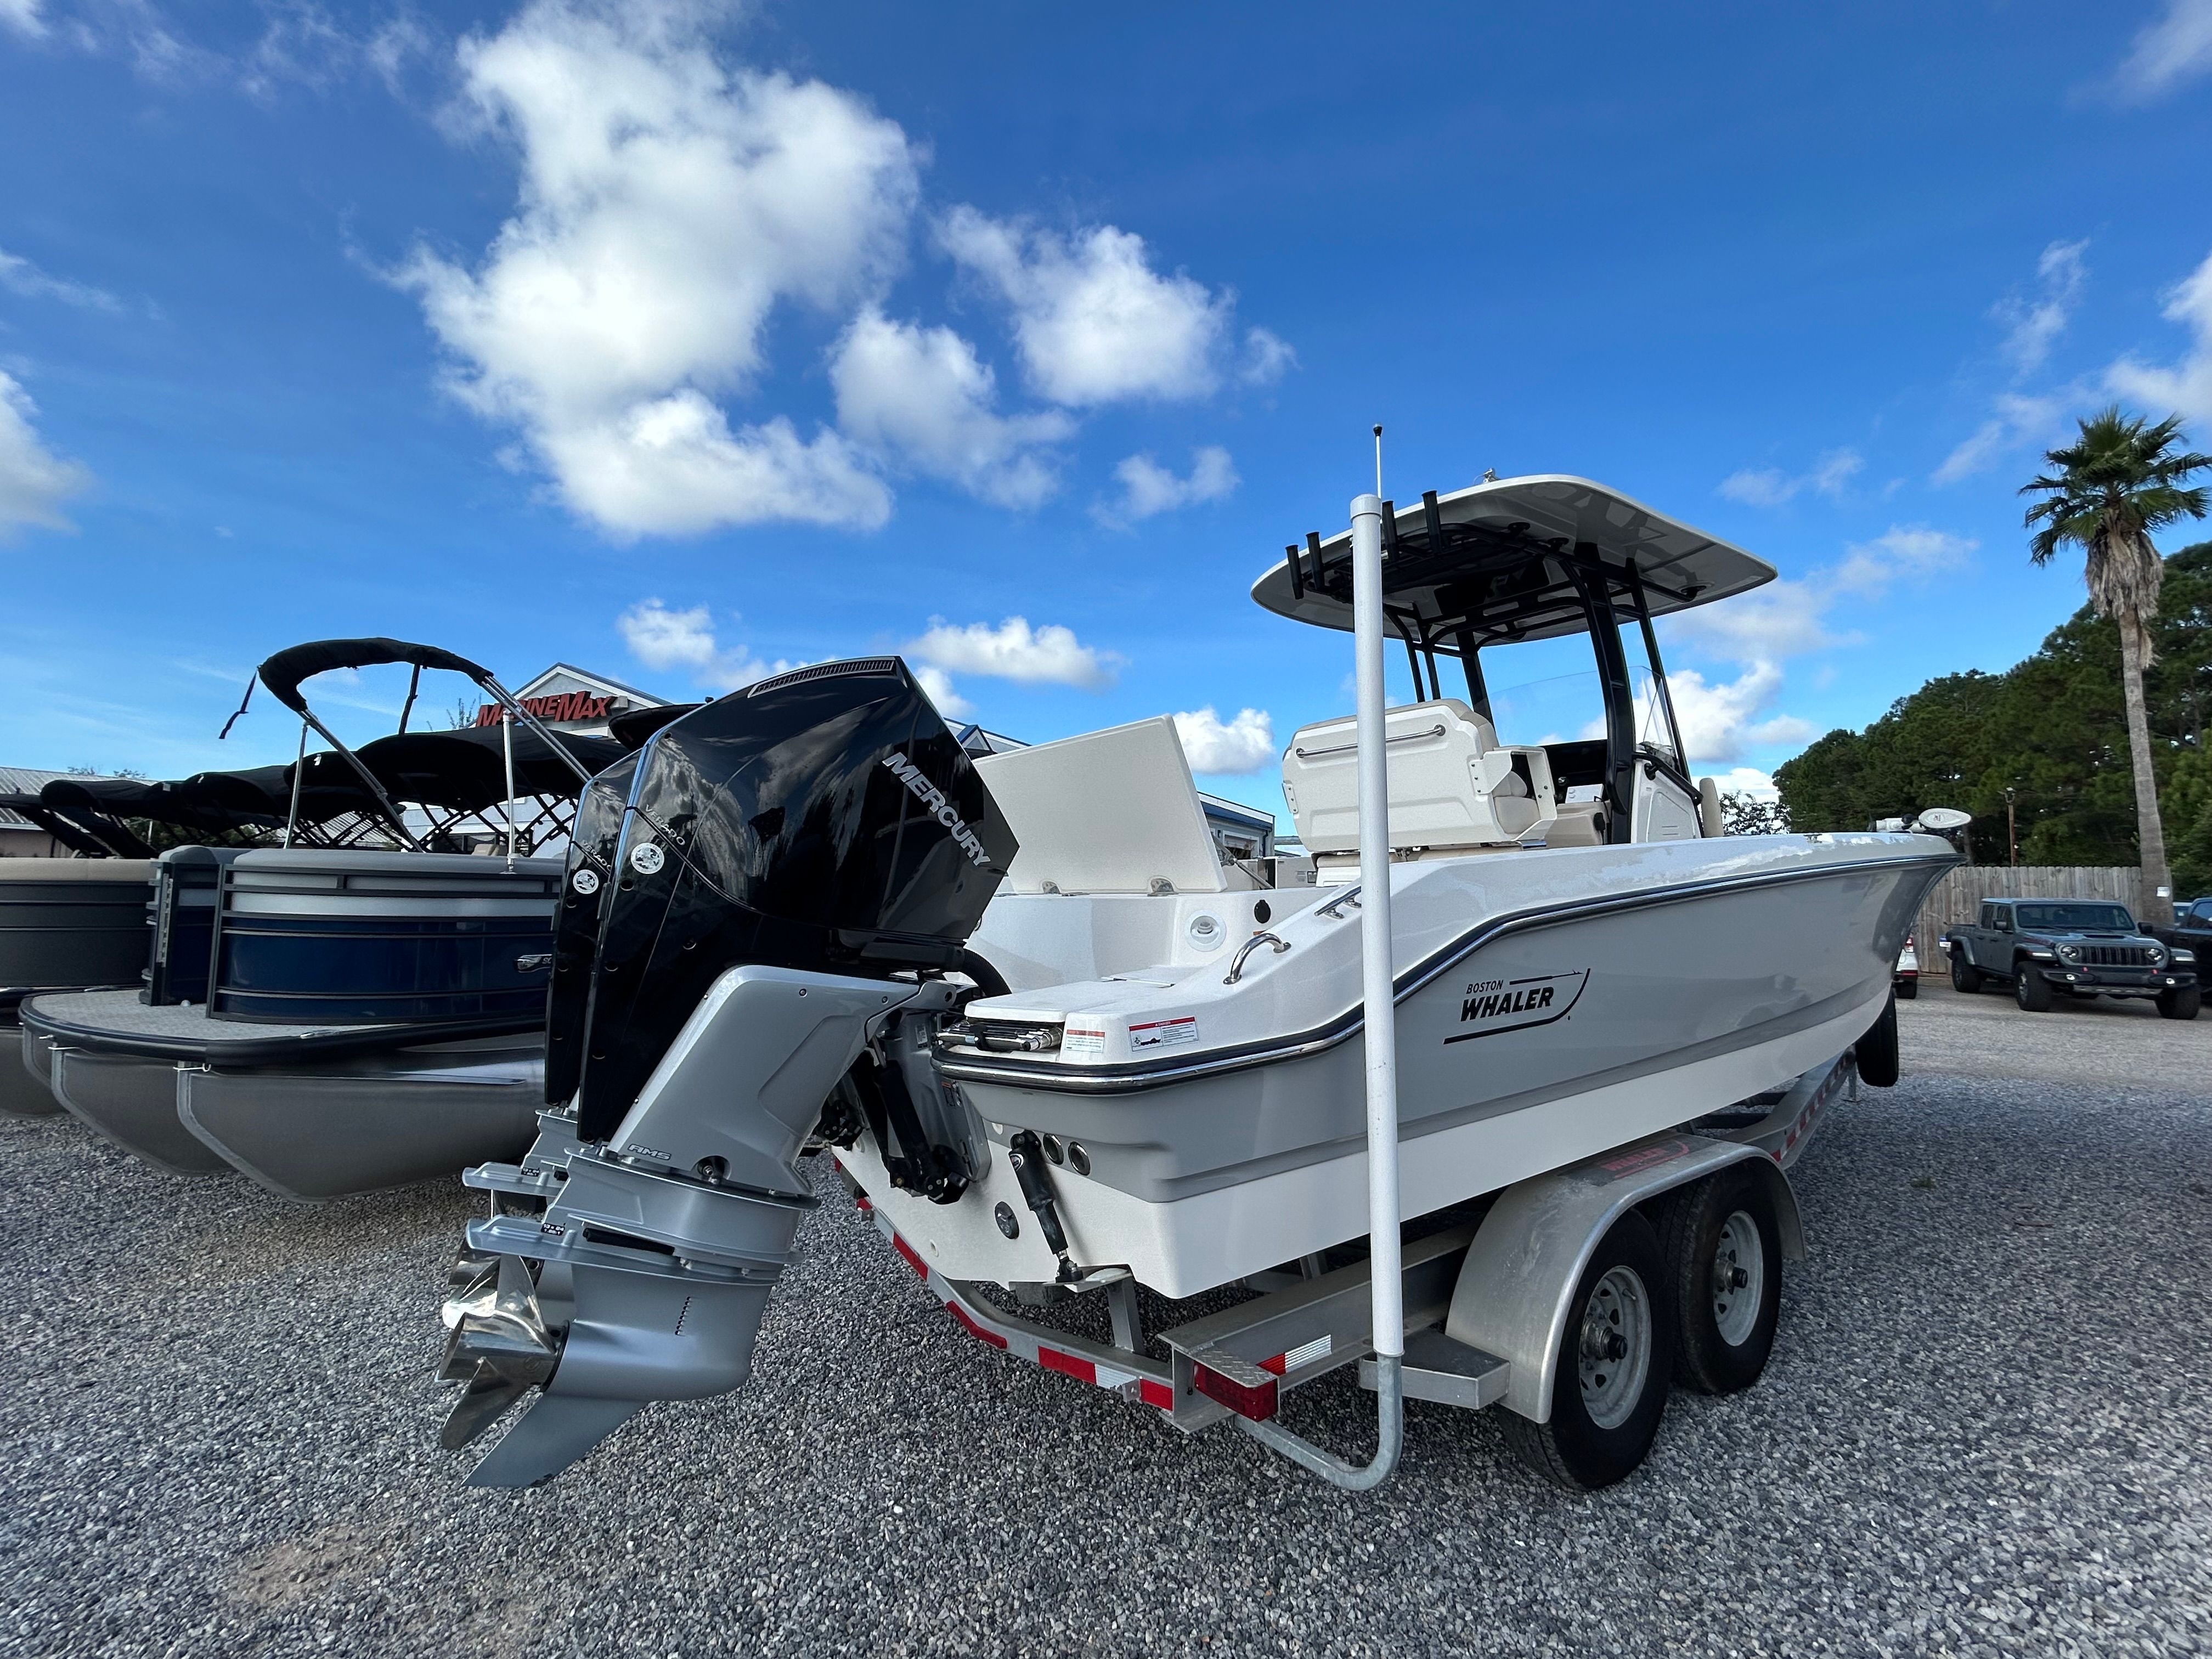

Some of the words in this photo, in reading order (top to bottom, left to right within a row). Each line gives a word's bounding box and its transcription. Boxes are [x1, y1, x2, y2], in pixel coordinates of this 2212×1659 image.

[476, 691, 613, 727] MAINEMAX
[646, 804, 686, 845] VERADO
[882, 752, 991, 866] MERCURY
[1460, 987, 1554, 1022] WHALER
[1466, 980, 1504, 994] BOSTON
[628, 1144, 671, 1160] AMS
